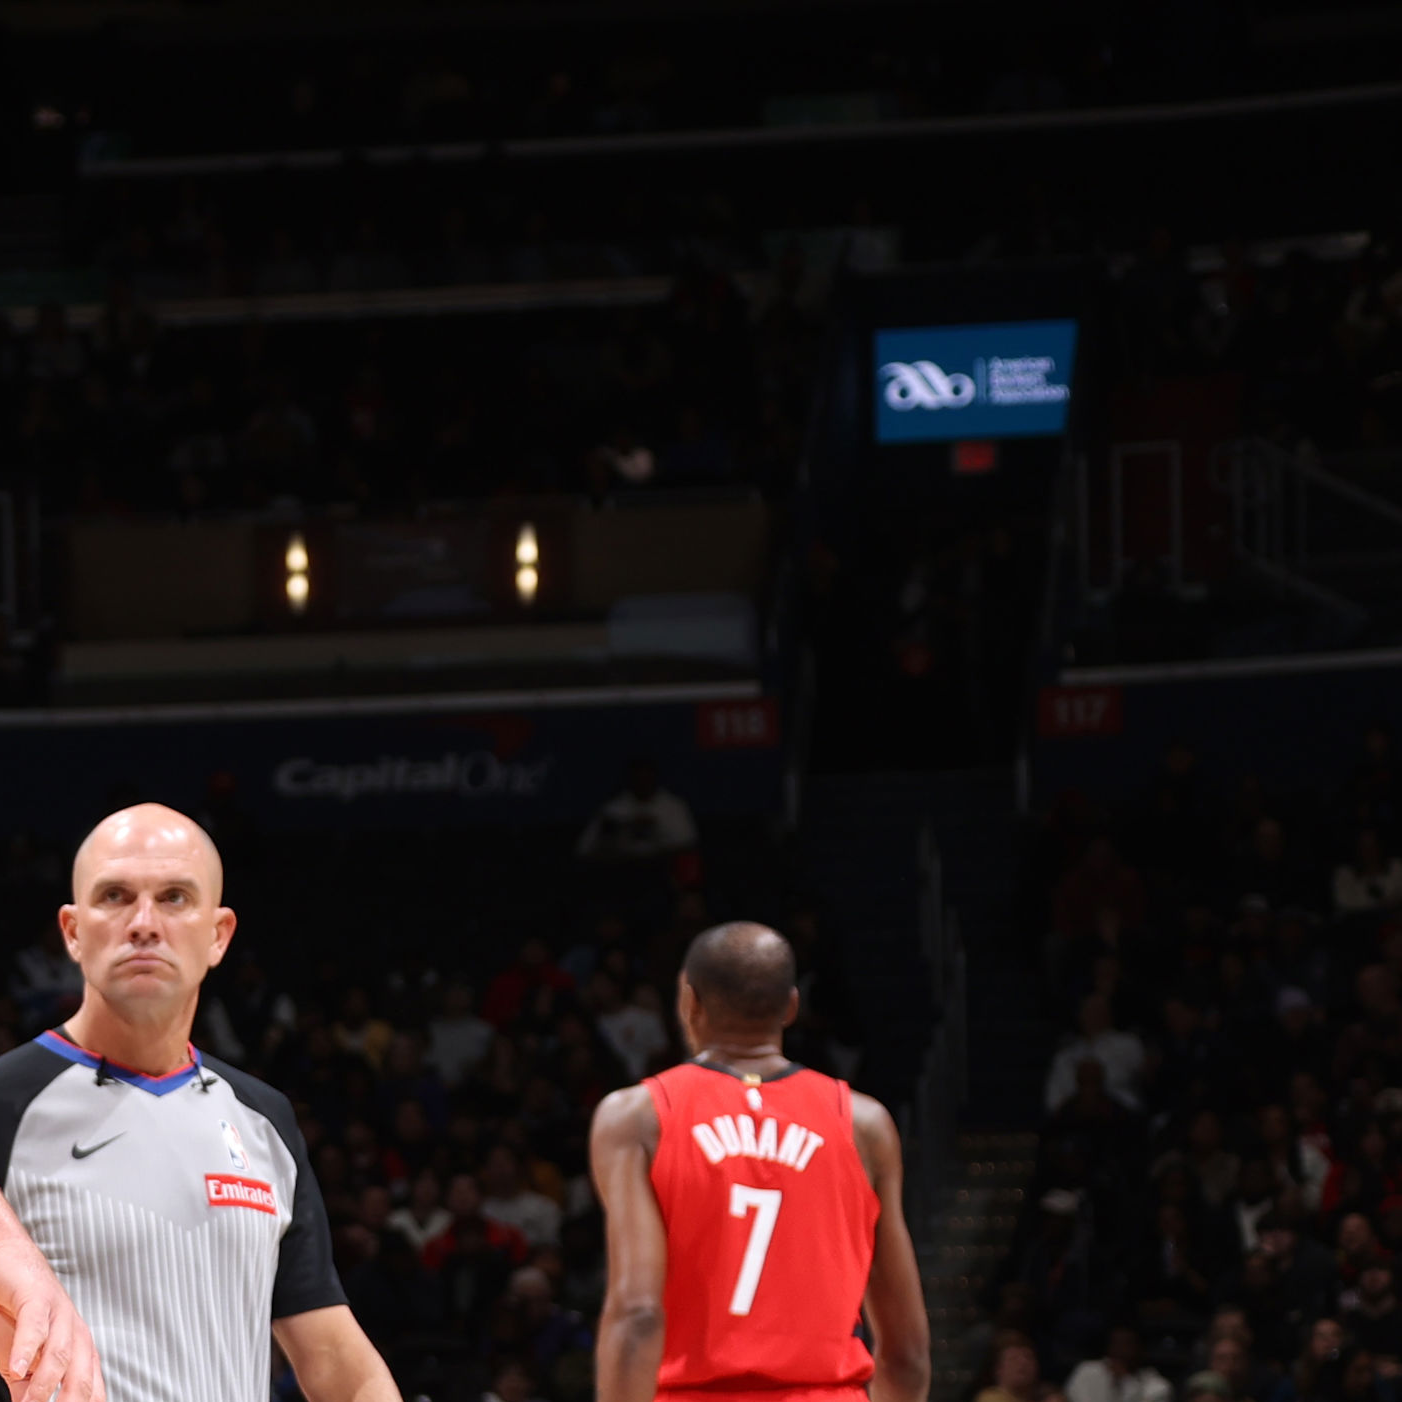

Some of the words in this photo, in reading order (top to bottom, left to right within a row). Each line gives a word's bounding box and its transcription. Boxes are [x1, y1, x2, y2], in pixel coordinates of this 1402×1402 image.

[691, 1114, 825, 1172] DURANT
[207, 1179, 276, 1209] Emirates
[728, 1182, 783, 1317] 7
